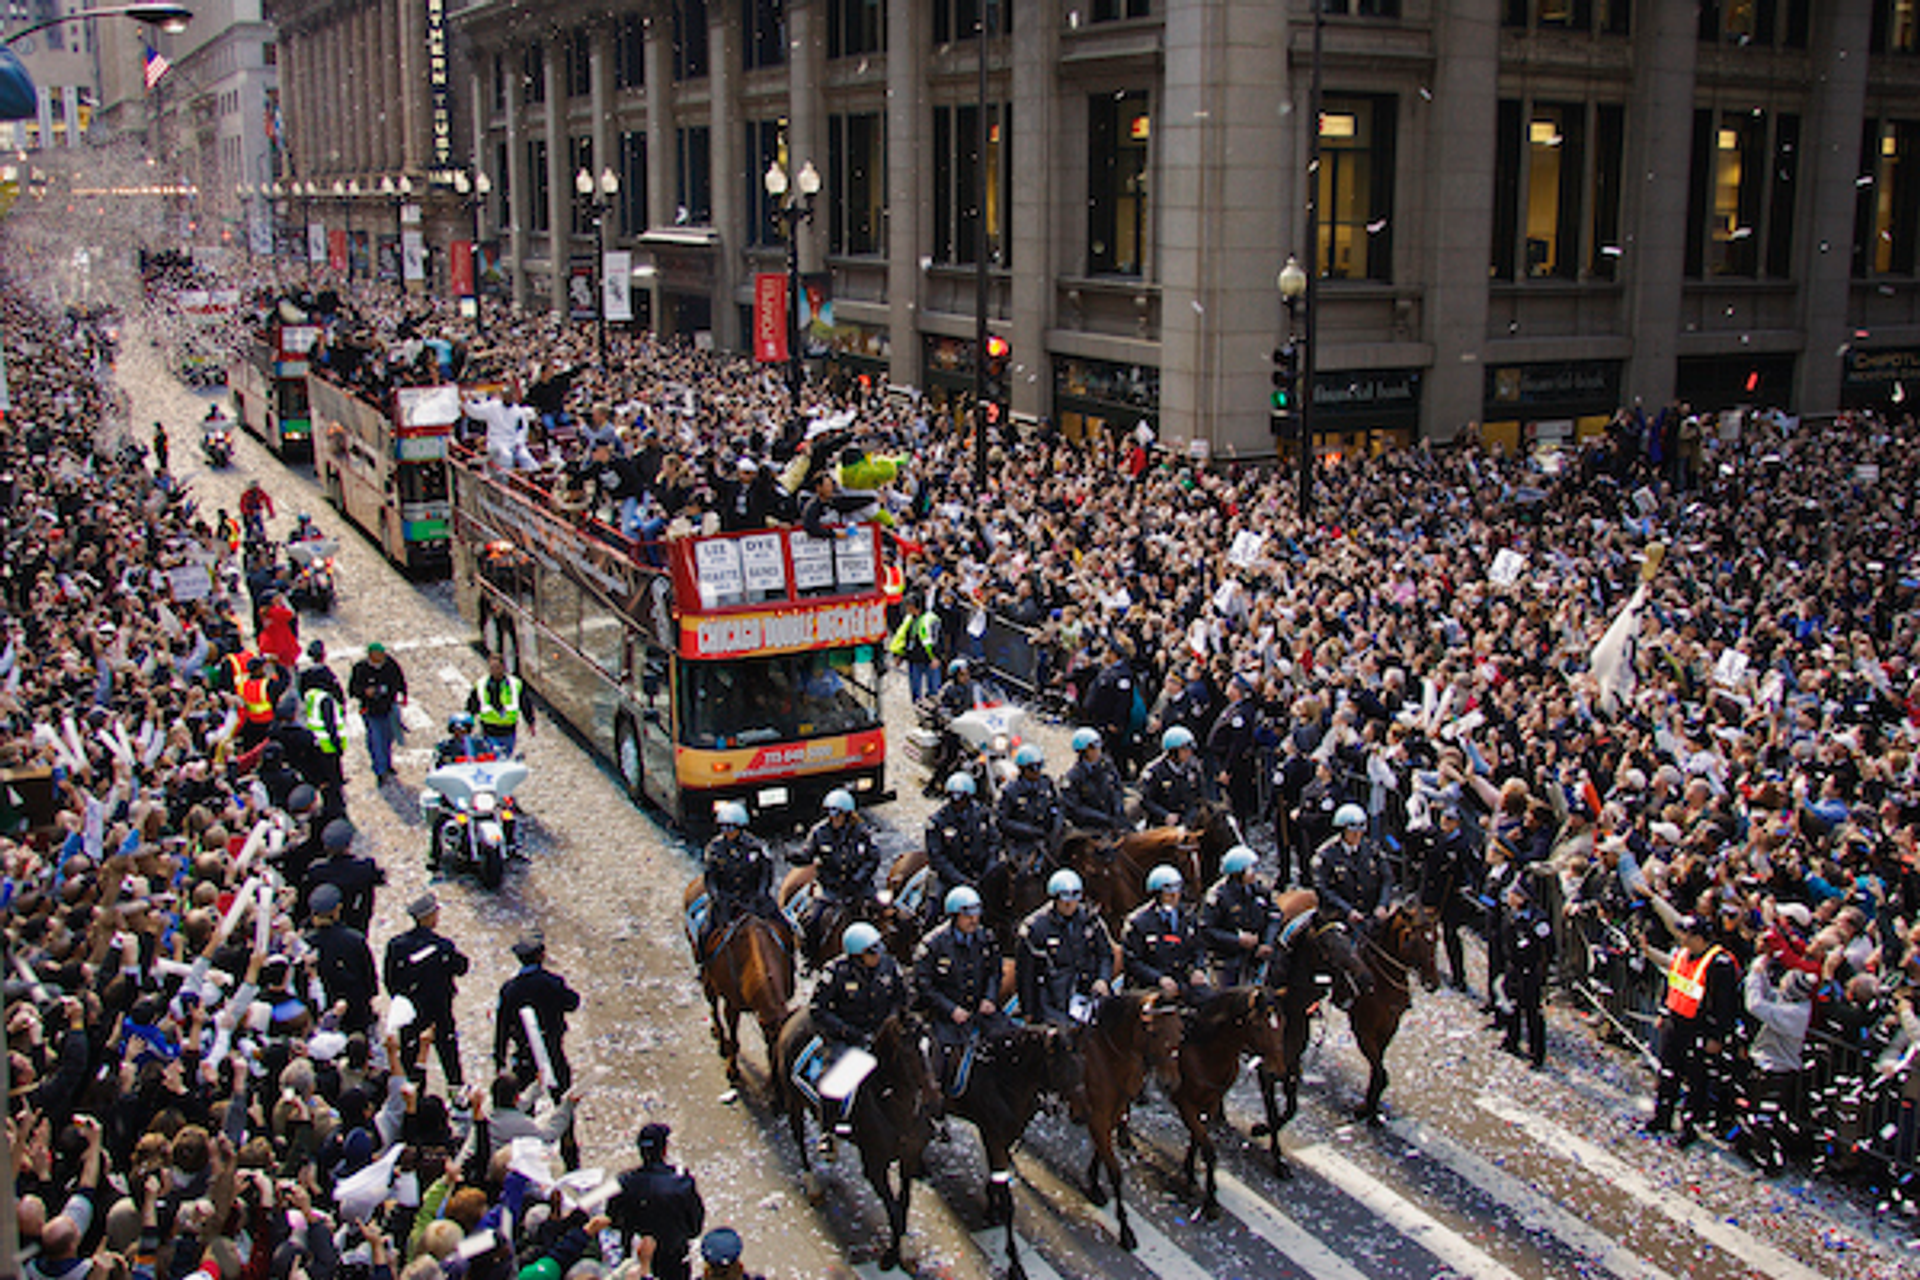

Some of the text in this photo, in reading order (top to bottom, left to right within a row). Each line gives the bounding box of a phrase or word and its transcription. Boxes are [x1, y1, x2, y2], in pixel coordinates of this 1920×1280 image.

[698, 618, 760, 653] CHICAGO
[764, 612, 815, 647] DOUBLE
[818, 606, 866, 641] DECKER
